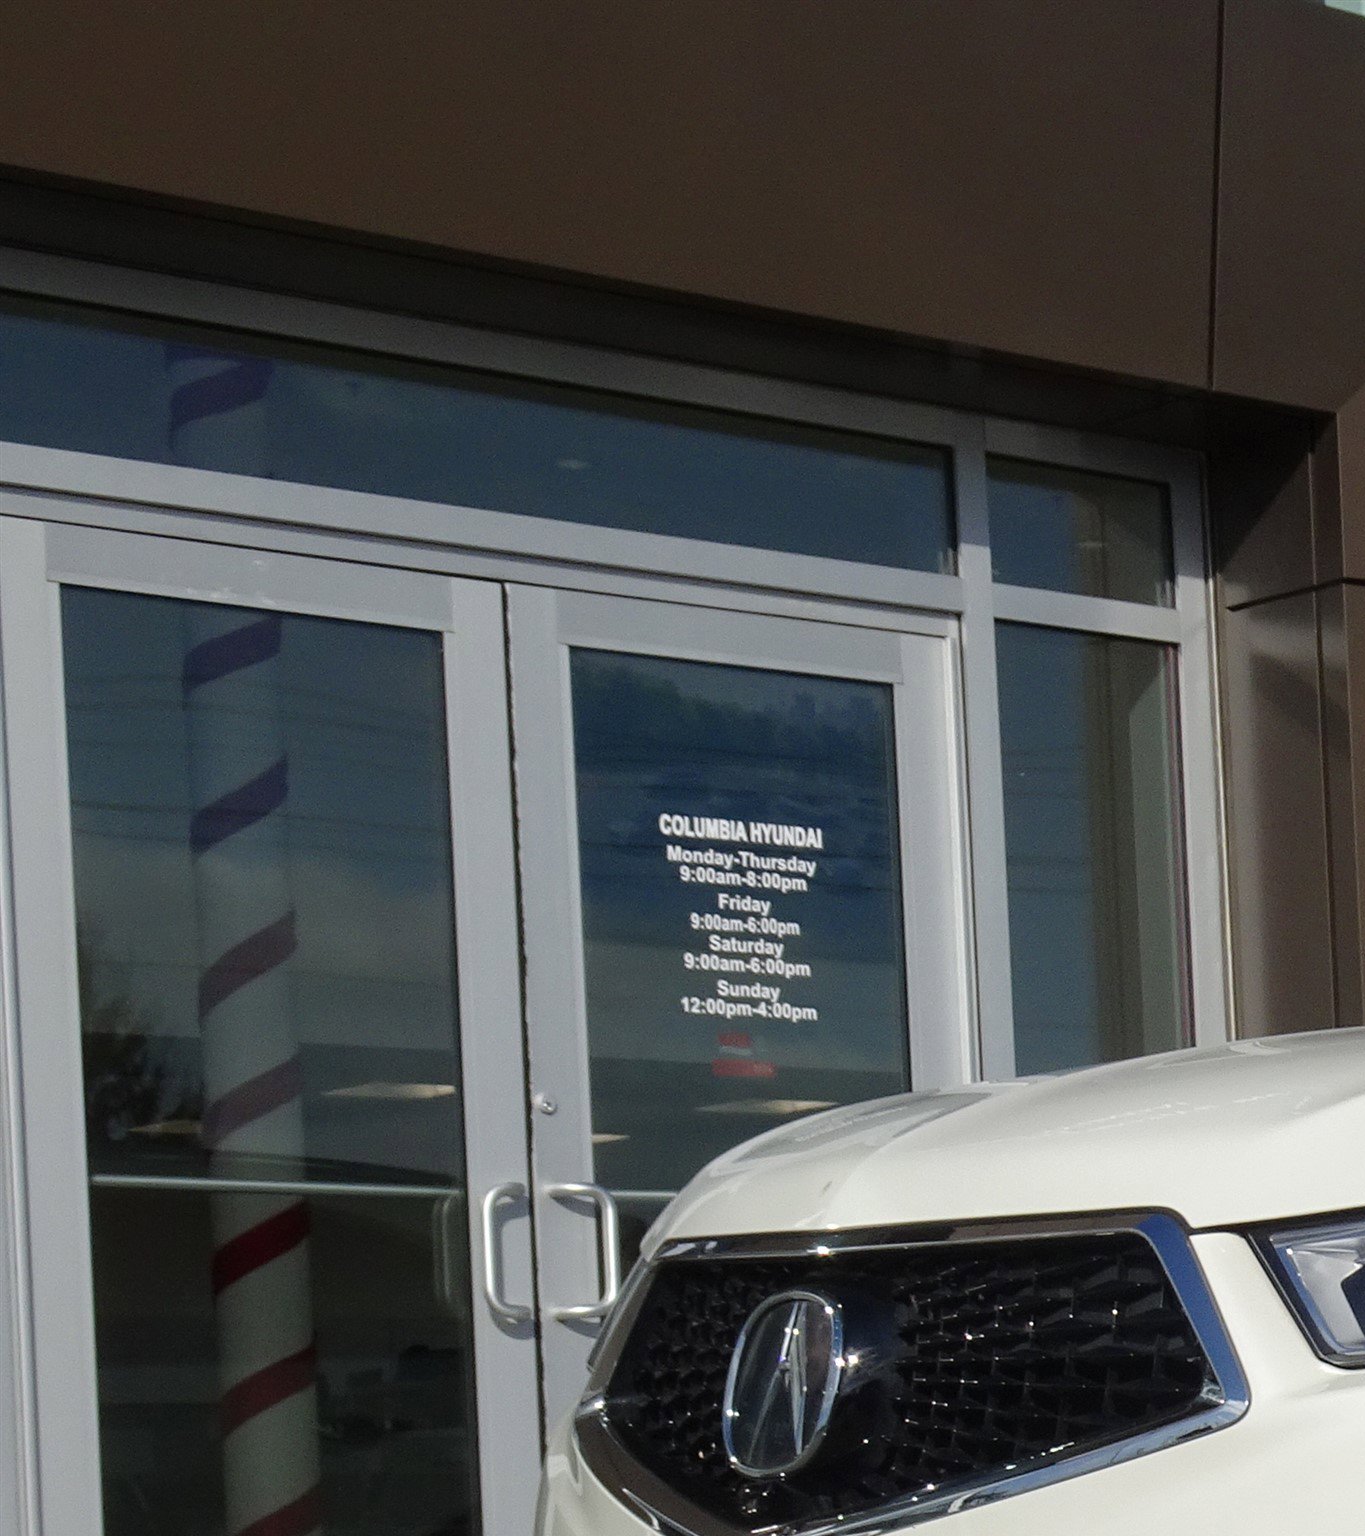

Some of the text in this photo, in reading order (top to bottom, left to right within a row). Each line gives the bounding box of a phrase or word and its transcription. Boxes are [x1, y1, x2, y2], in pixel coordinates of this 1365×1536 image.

[658, 813, 823, 849] COLUMBIA HYUNDAI
[666, 845, 816, 877] Monday-Thursday
[680, 865, 808, 893] 9:00am-8:00pm
[717, 893, 771, 916] Friday
[690, 913, 800, 937] 9:00am-6:00pm
[709, 934, 784, 958] Saturday
[683, 953, 811, 978] 9:00am-6:00pm
[716, 980, 780, 1001] Sunday
[680, 997, 818, 1022] 12:00pm-4:00pm
